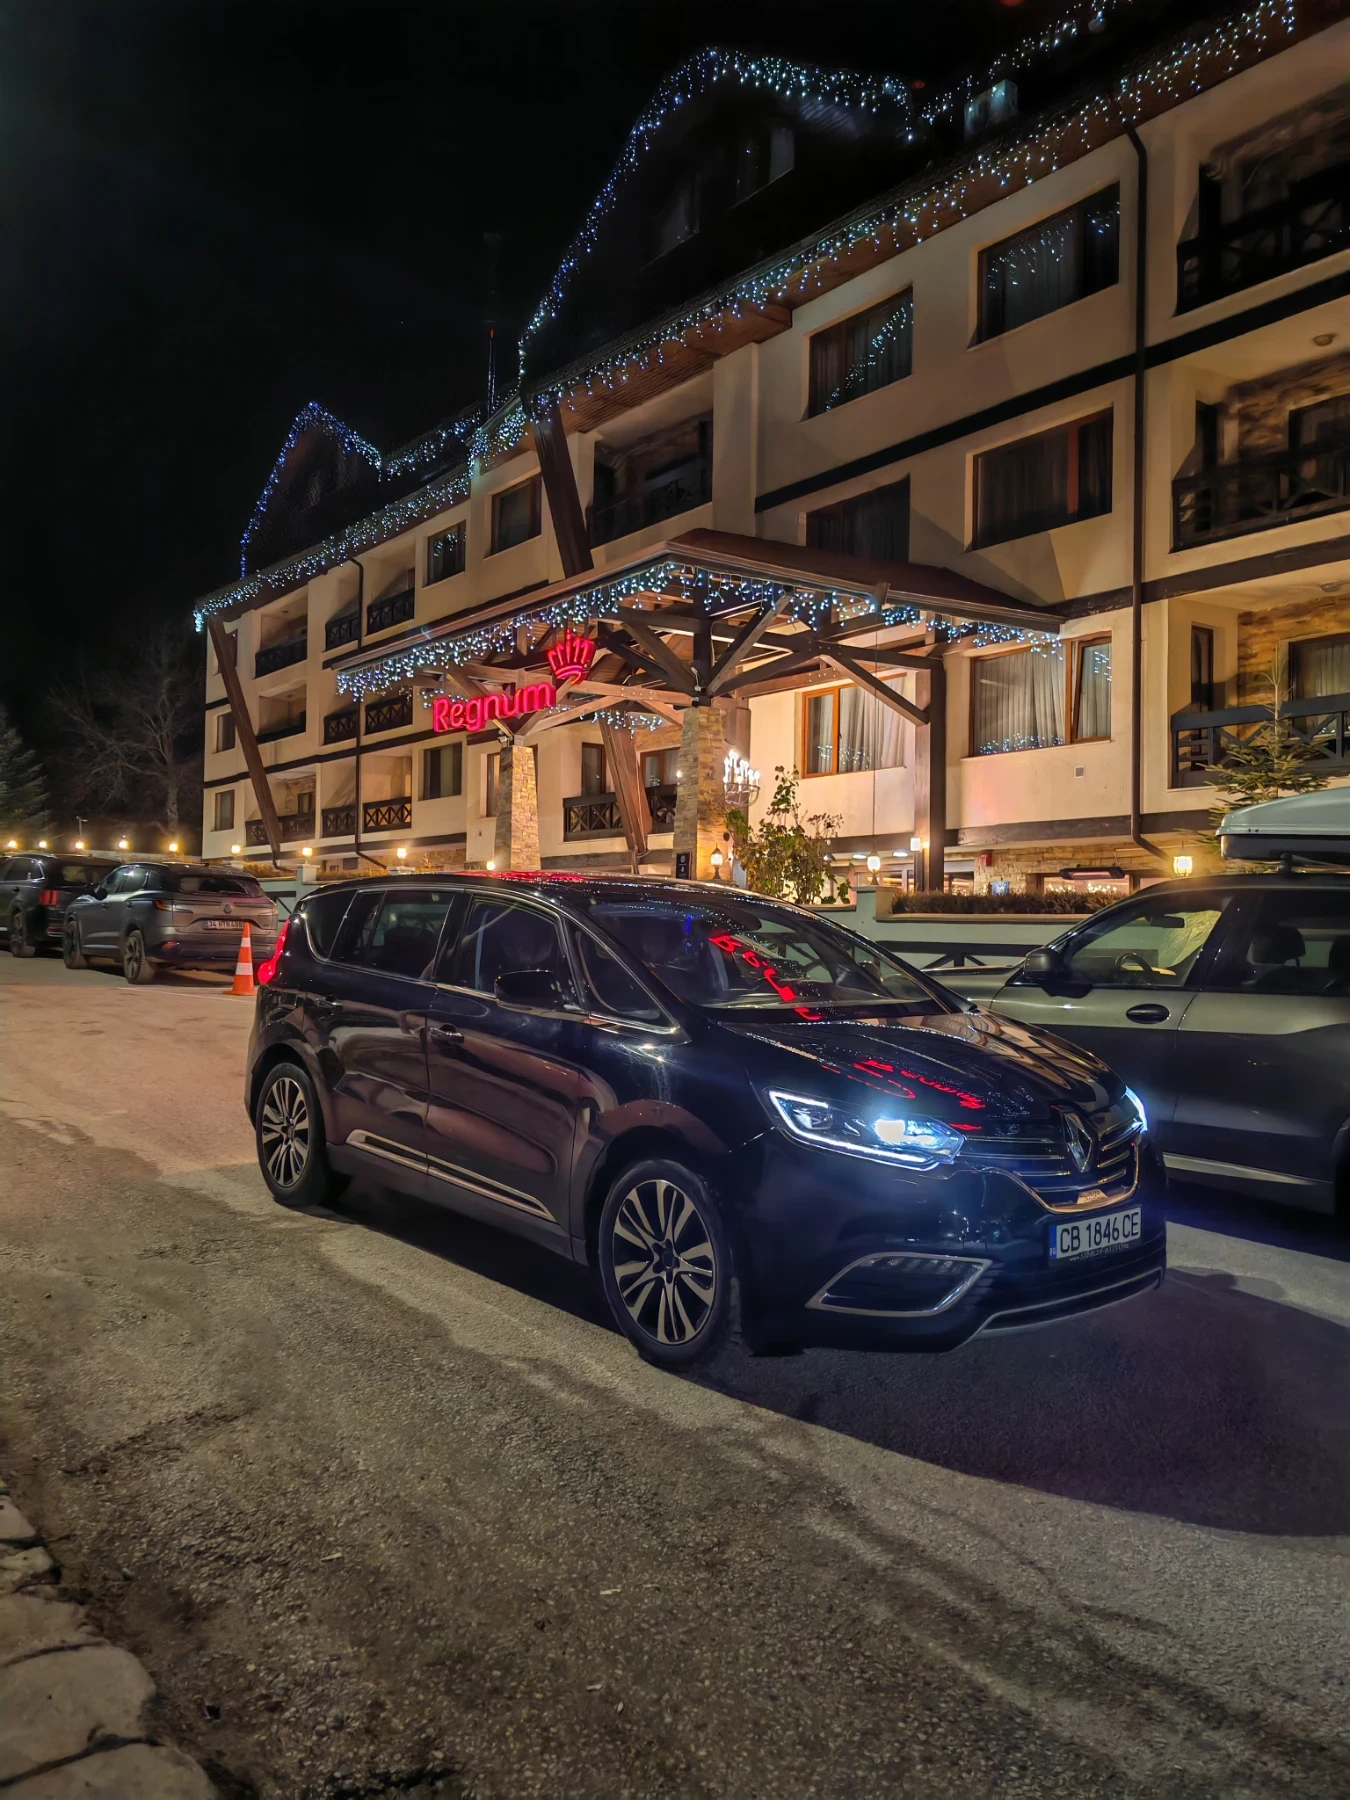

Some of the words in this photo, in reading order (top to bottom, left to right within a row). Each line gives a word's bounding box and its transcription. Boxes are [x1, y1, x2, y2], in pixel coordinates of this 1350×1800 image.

[433, 682, 556, 732] Regnum
[1060, 1225, 1081, 1254] CB
[1086, 1217, 1120, 1248] 1846
[1122, 1212, 1139, 1239] CE
